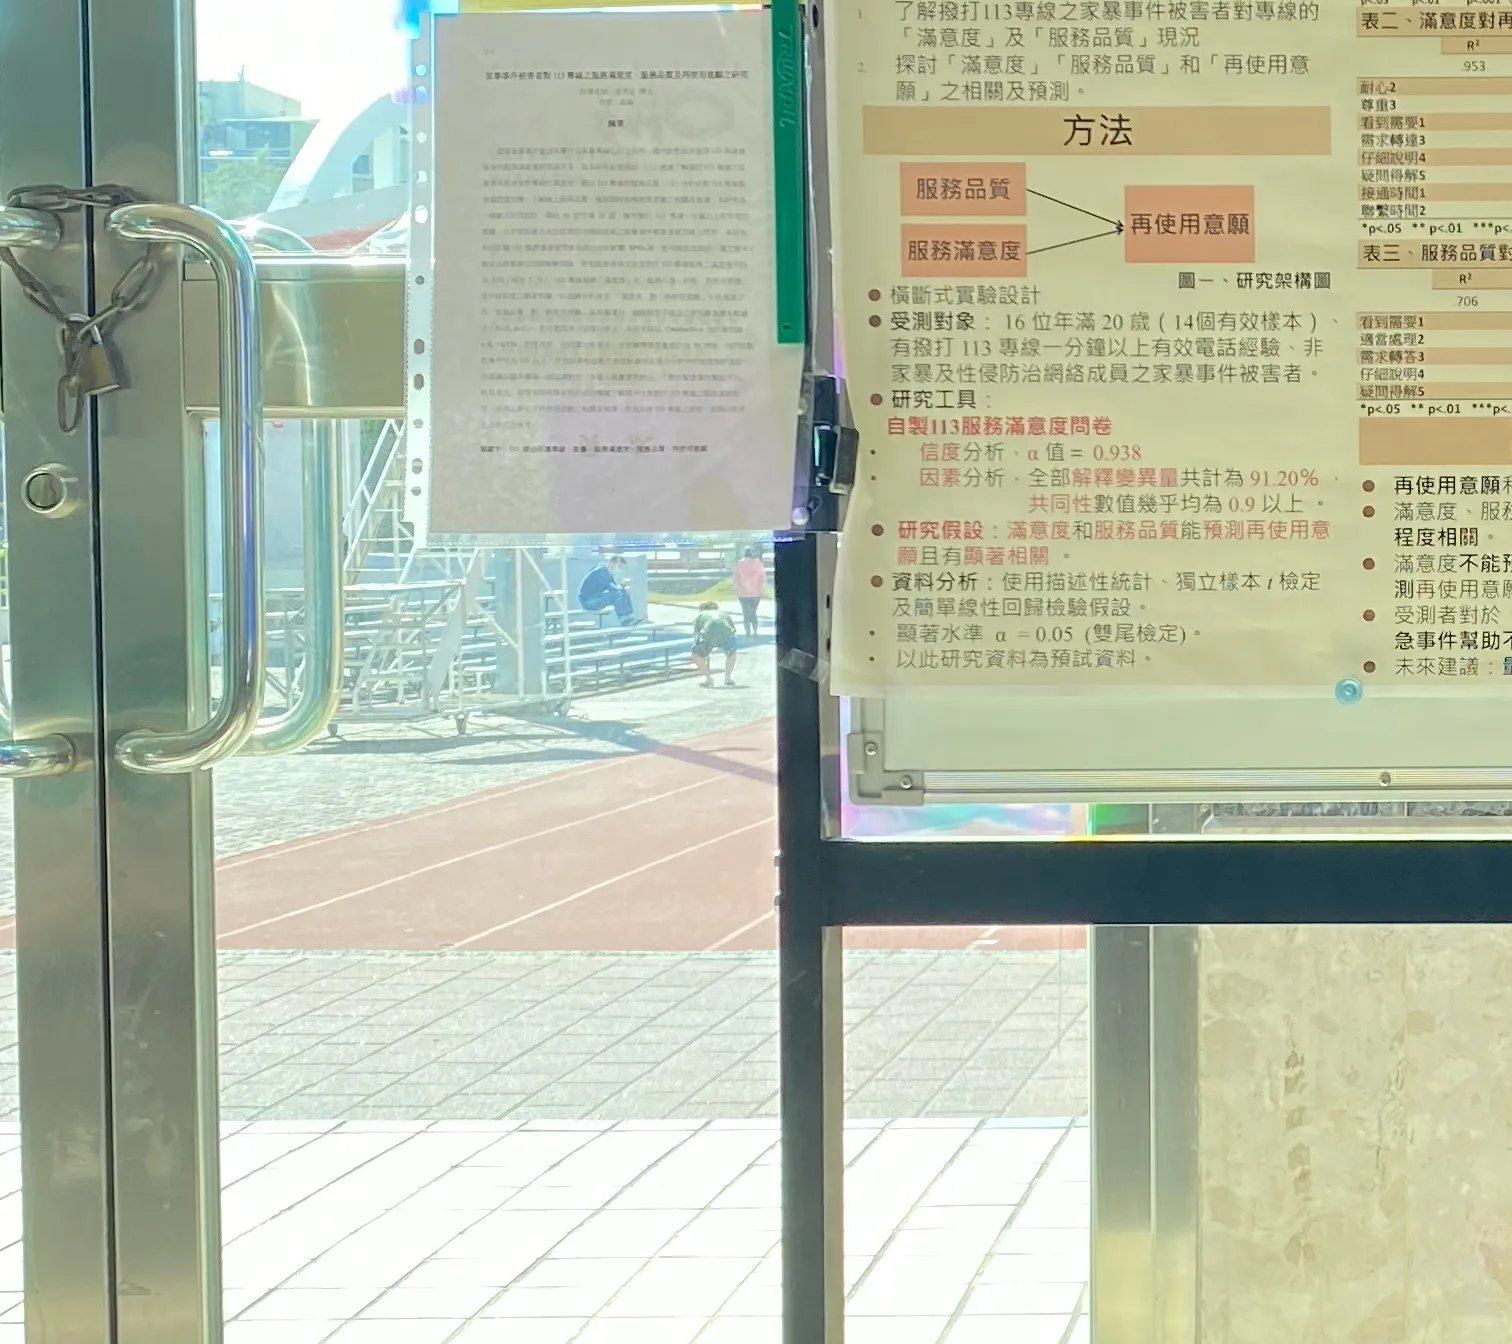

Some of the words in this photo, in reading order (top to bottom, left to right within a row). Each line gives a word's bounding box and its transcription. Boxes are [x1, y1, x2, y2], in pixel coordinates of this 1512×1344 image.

[1063, 113, 1133, 147] 方法
[916, 177, 1011, 201] 服務品質
[1129, 212, 1250, 236] 再使用意願
[907, 239, 1021, 262] 服務滿意度
[1006, 313, 1026, 331] 16
[1031, 311, 1096, 332] 位年滿
[1102, 313, 1124, 331] 20
[889, 336, 955, 358] 有撥打
[963, 339, 992, 357] 113
[887, 415, 1112, 437] 自製113服務滿意度問卷
[1092, 444, 1142, 462] 0.938
[1228, 496, 1256, 513] 0.9
[1035, 626, 1073, 643] 0.05
